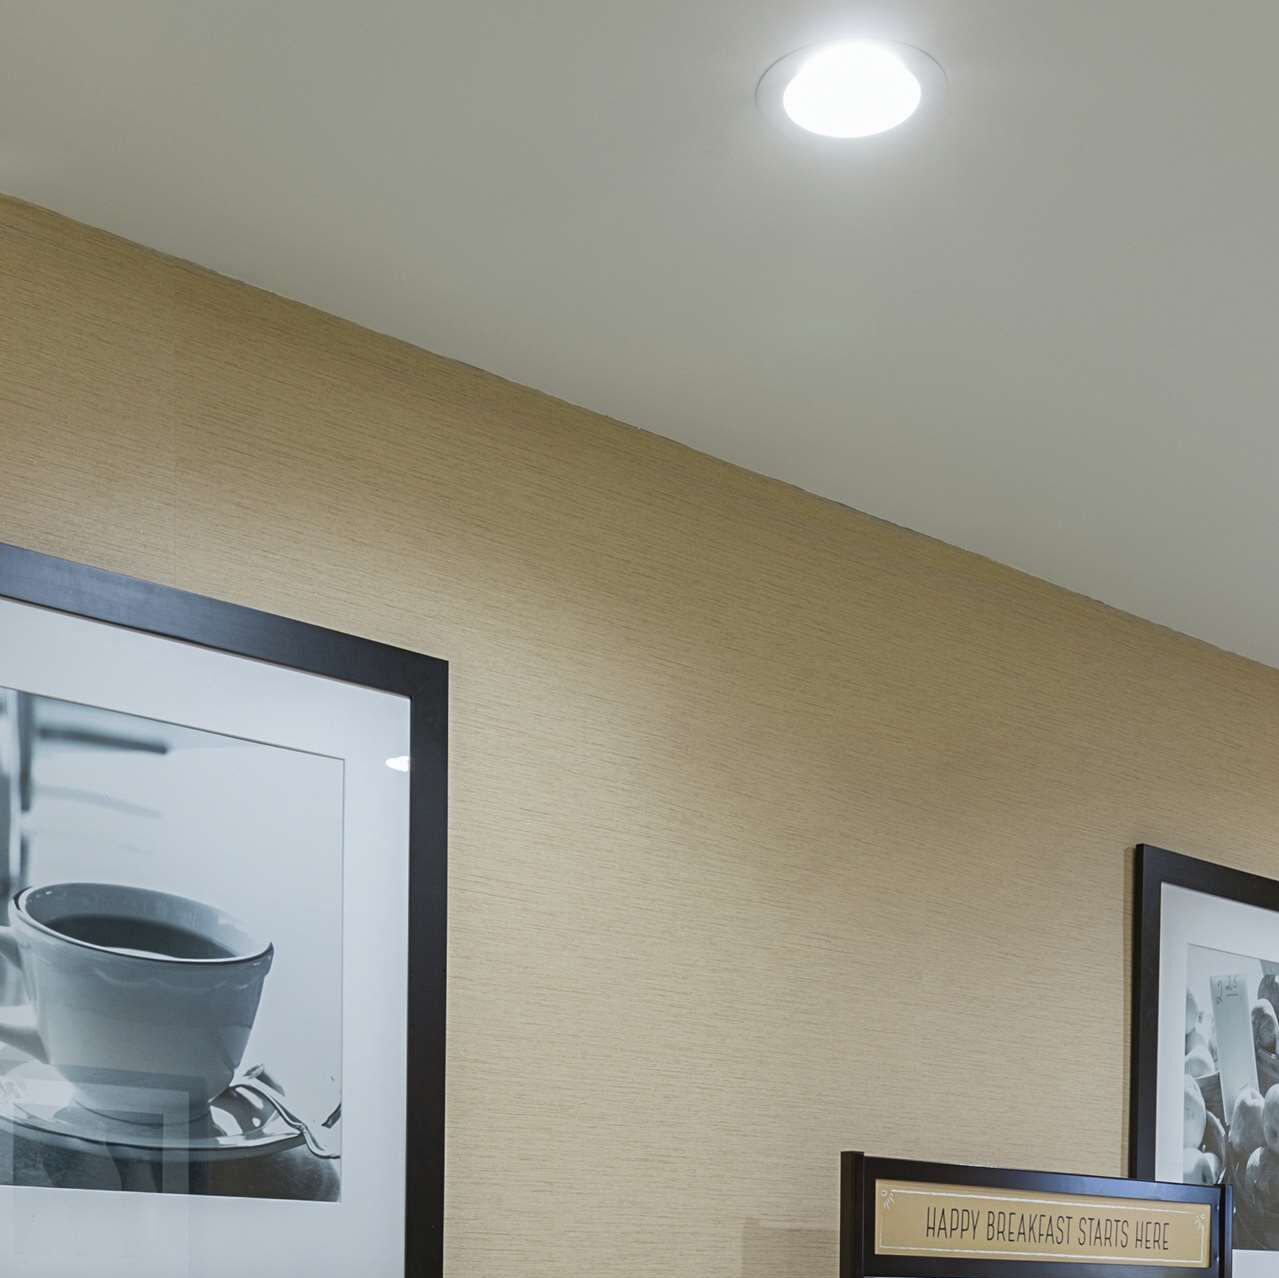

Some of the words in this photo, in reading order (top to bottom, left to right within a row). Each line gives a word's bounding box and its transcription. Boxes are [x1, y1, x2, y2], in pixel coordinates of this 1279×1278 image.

[925, 1207, 981, 1241] HAPPY
[986, 1211, 1073, 1246] BREAKFAST
[1078, 1217, 1130, 1249] STARTS
[1135, 1221, 1170, 1251] HERE
